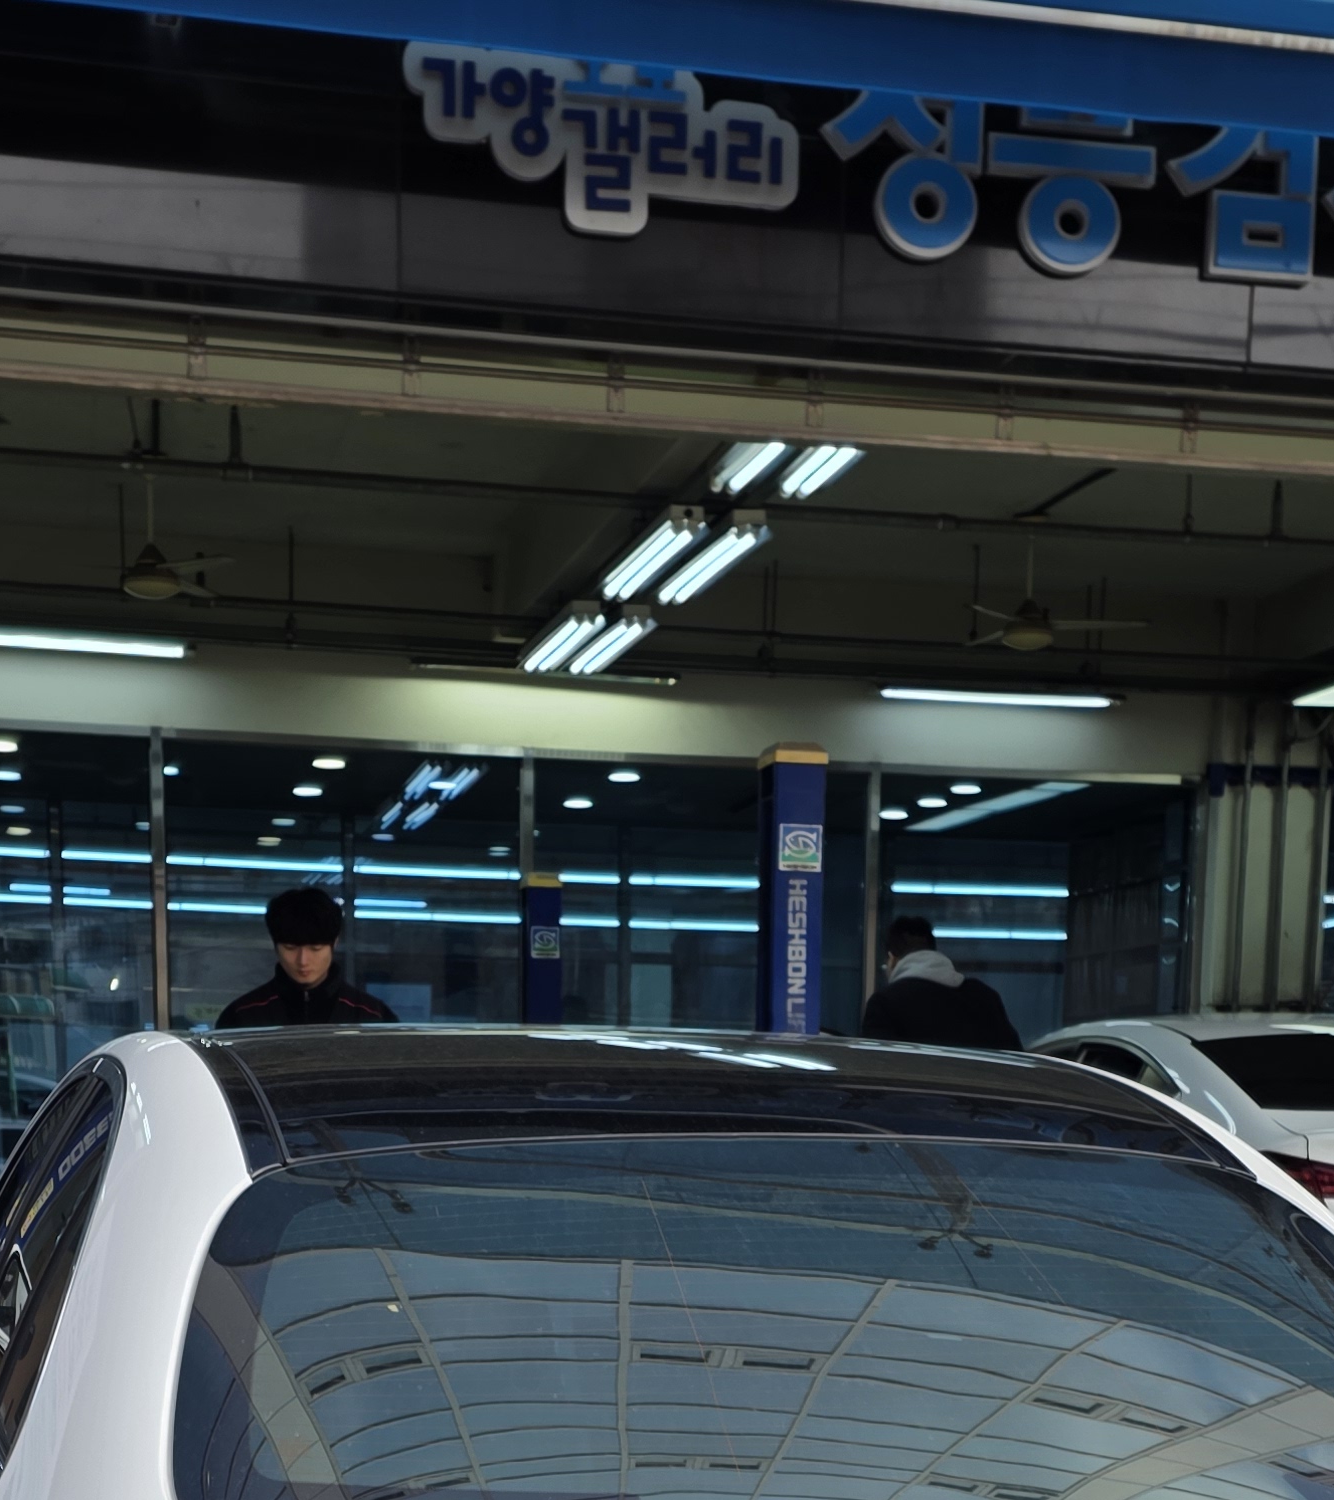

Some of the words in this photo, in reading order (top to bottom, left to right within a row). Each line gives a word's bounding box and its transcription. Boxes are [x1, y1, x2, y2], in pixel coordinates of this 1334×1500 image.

[421, 54, 555, 158] 가양
[561, 106, 783, 213] 갤러리
[786, 878, 808, 997] HESHBON
